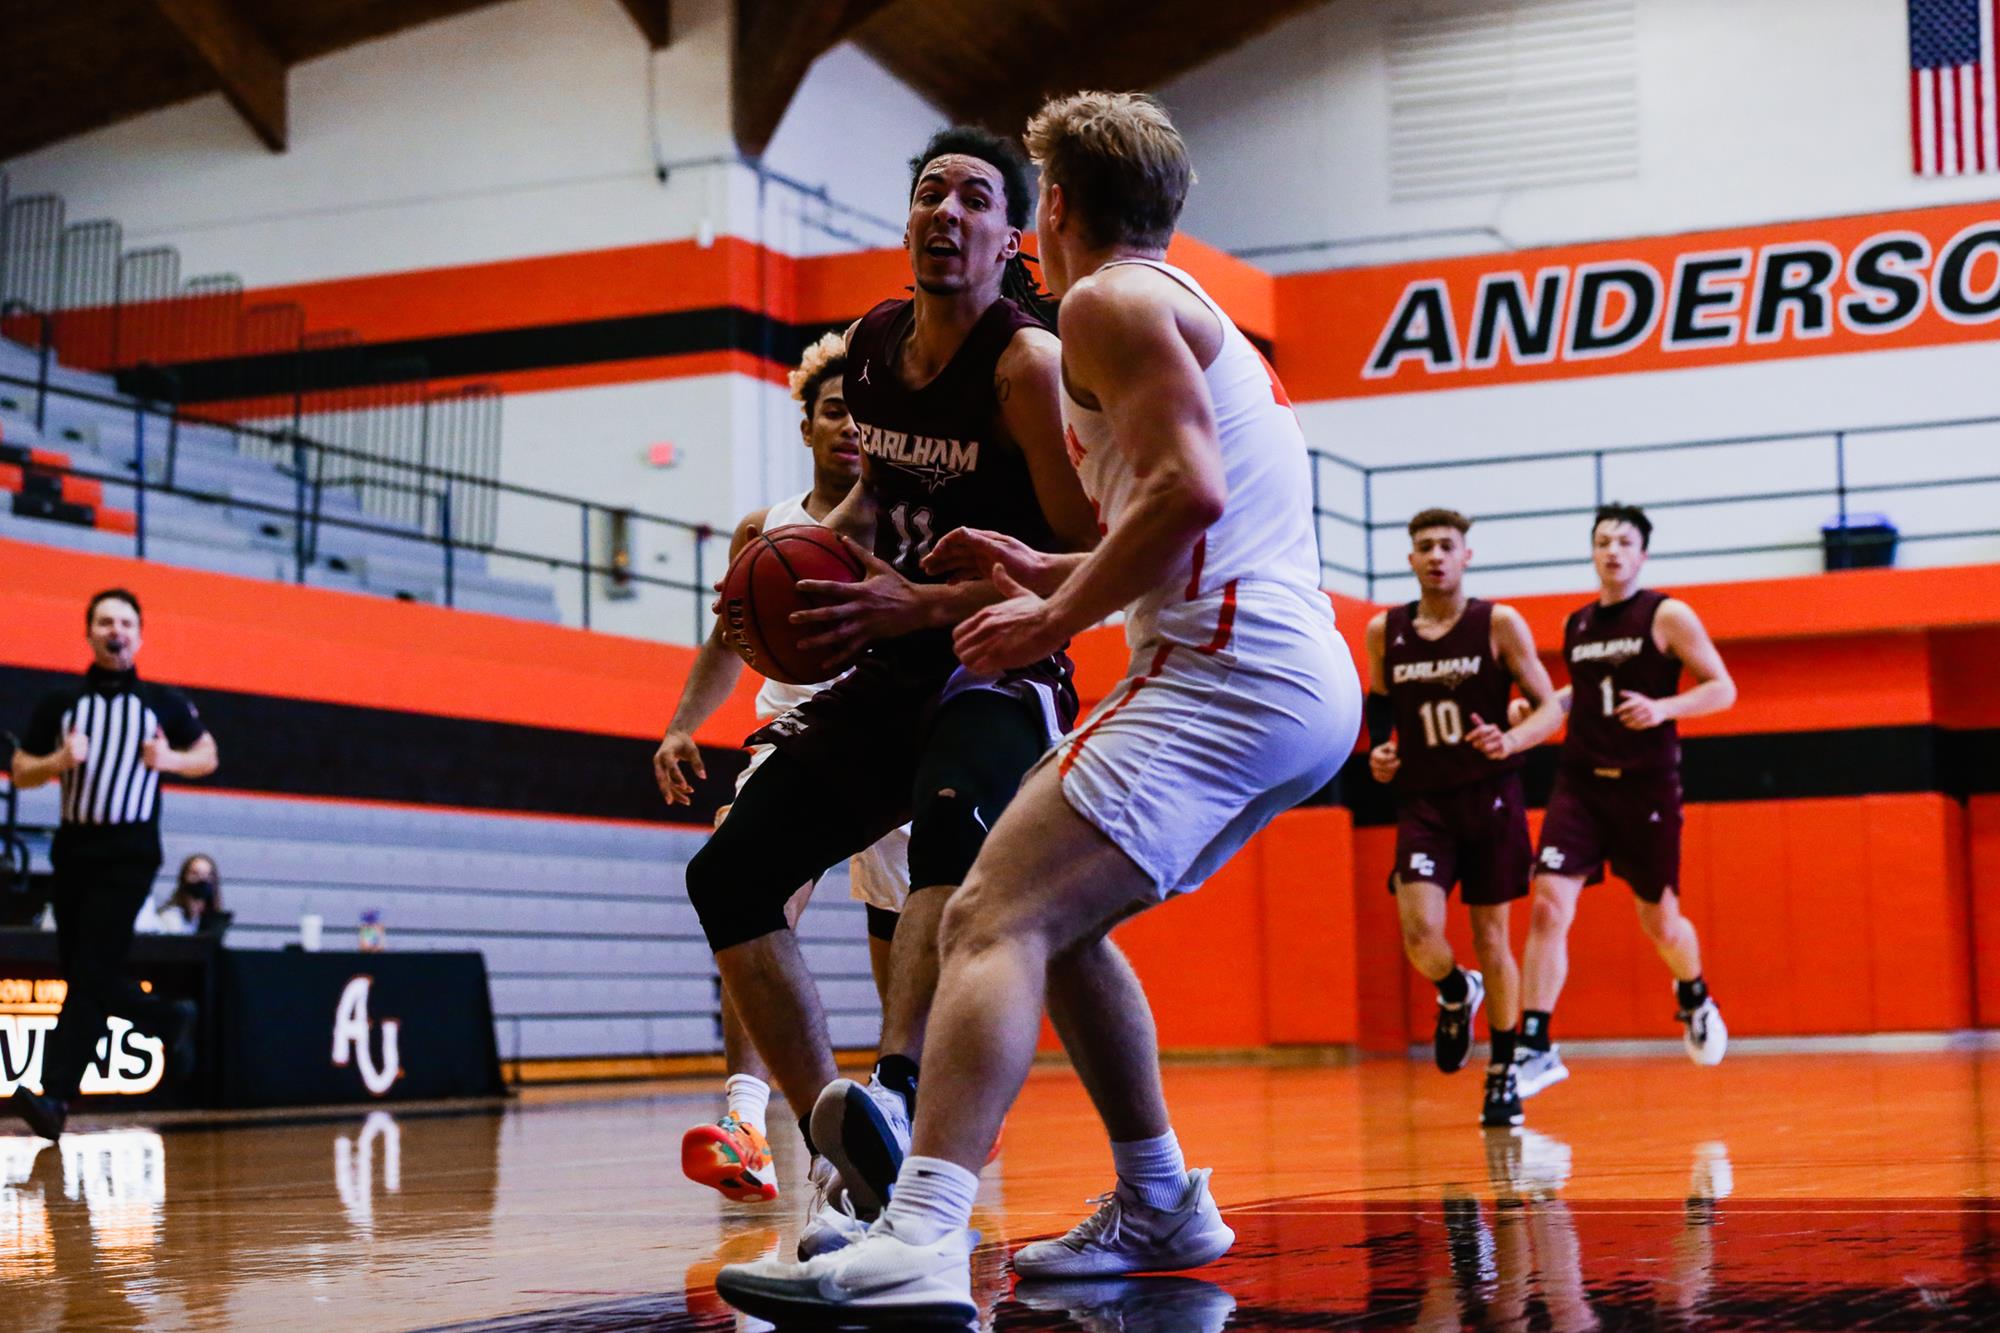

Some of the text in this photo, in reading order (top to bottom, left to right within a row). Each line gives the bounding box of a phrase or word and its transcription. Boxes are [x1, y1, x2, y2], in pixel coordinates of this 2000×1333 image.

[857, 422, 979, 472] EARLHAM
[889, 502, 932, 568] 11
[1600, 675, 1614, 716] 1
[1420, 700, 1462, 746] 10
[332, 974, 401, 1095] AU
